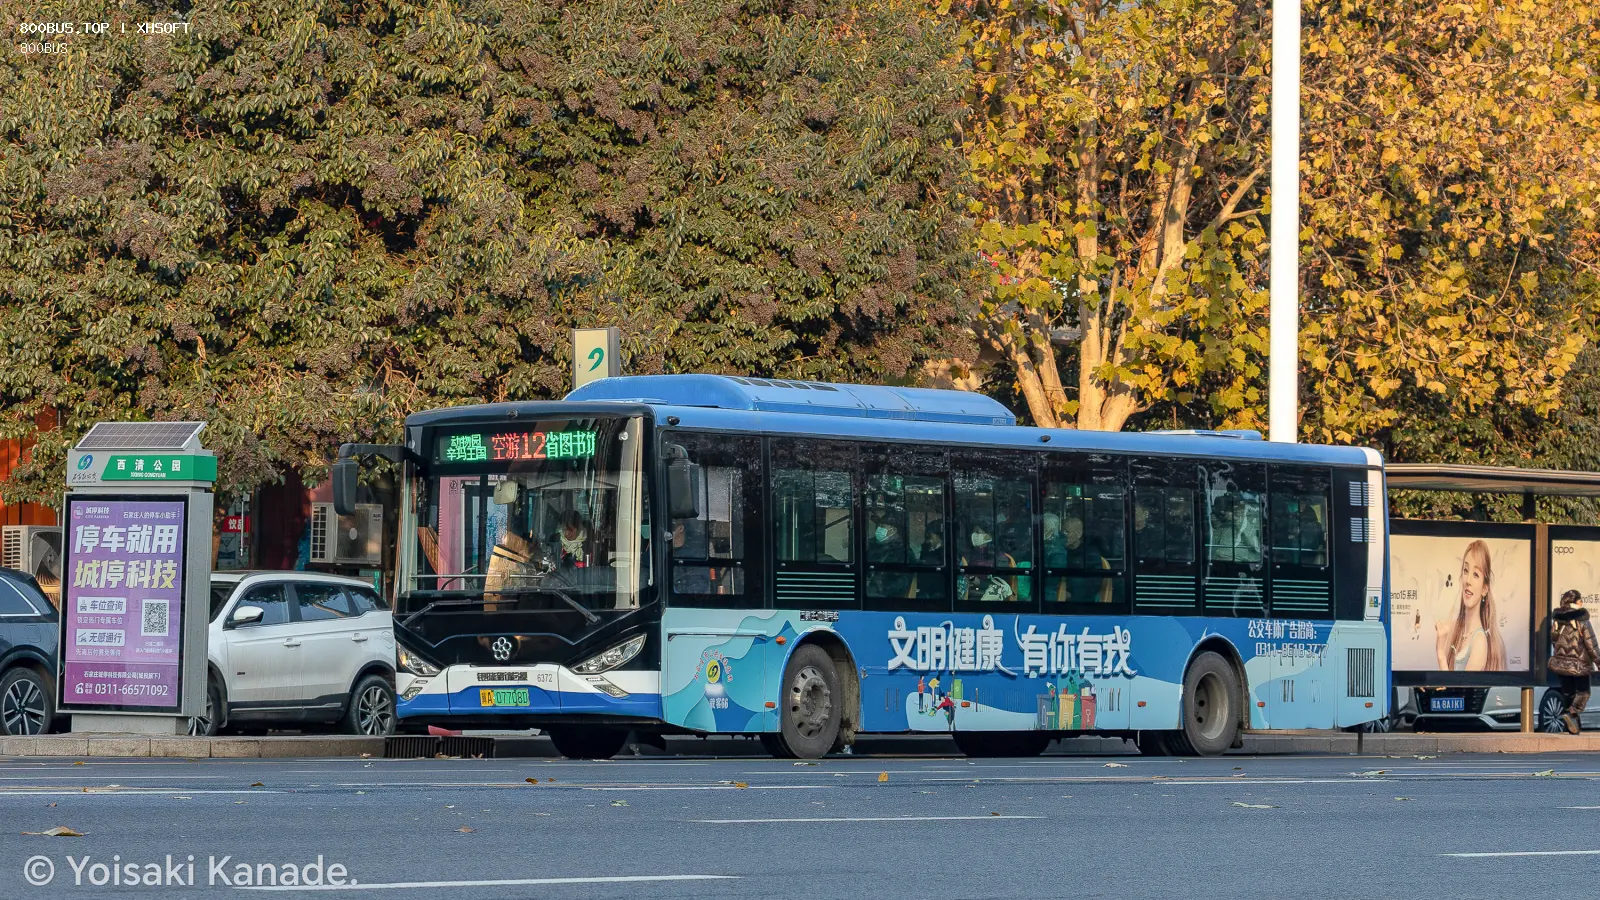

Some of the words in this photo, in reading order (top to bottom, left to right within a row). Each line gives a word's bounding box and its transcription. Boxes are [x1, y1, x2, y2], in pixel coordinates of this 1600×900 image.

[450, 433, 481, 448] 动物园
[116, 459, 181, 472] 西清公园
[74, 524, 179, 554] 停车就用
[73, 560, 178, 589] 城停科技
[90, 600, 123, 611] 车位查询
[88, 632, 122, 643] 无感通行
[888, 615, 1018, 677] 文明健康
[1014, 615, 1138, 678] 有你有我
[537, 673, 553, 682] 6372
[95, 683, 168, 696] 0311-66571092
